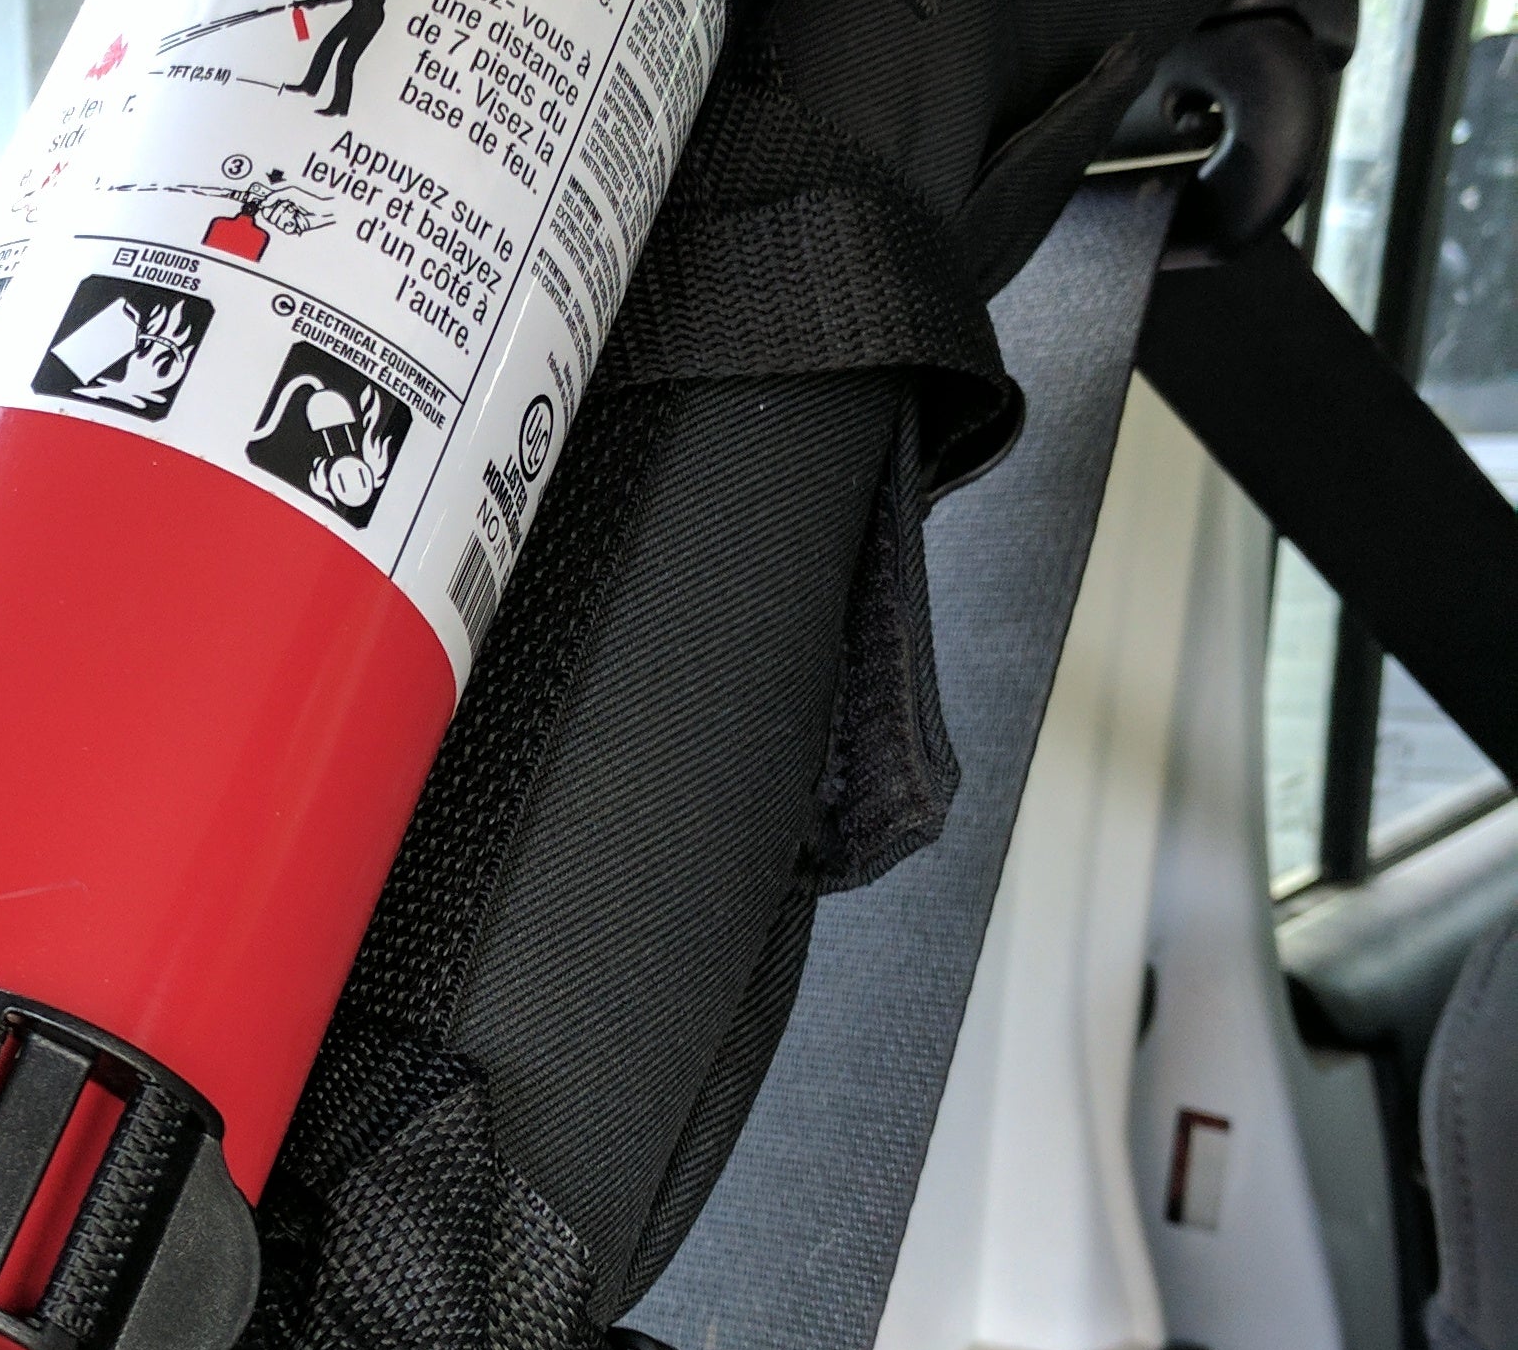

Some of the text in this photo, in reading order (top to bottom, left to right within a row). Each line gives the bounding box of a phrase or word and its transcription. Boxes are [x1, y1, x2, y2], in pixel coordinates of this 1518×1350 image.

[167, 65, 192, 77] 7FT
[213, 68, 231, 85] M)
[406, 13, 567, 135] de 7 pieds du
[487, 20, 578, 105] distance
[522, 5, 574, 61] vous
[576, 49, 590, 79] à
[399, 76, 536, 194] base de feu.
[414, 49, 554, 166] feu. Visez la
[301, 151, 501, 294] levier et balayez
[330, 130, 512, 262] Appuyez sur le
[132, 264, 200, 291] LIQUIDES
[140, 248, 199, 272] LIQUIDS
[356, 216, 487, 325] d'un côté à
[298, 301, 376, 355] ELECTRICAL
[379, 346, 446, 405] EQUIPMENT
[395, 274, 469, 355] l'autre.
[291, 316, 445, 429] ÉQUIPEMENT ÉLECTRIQUE
[501, 452, 528, 519] LISTED
